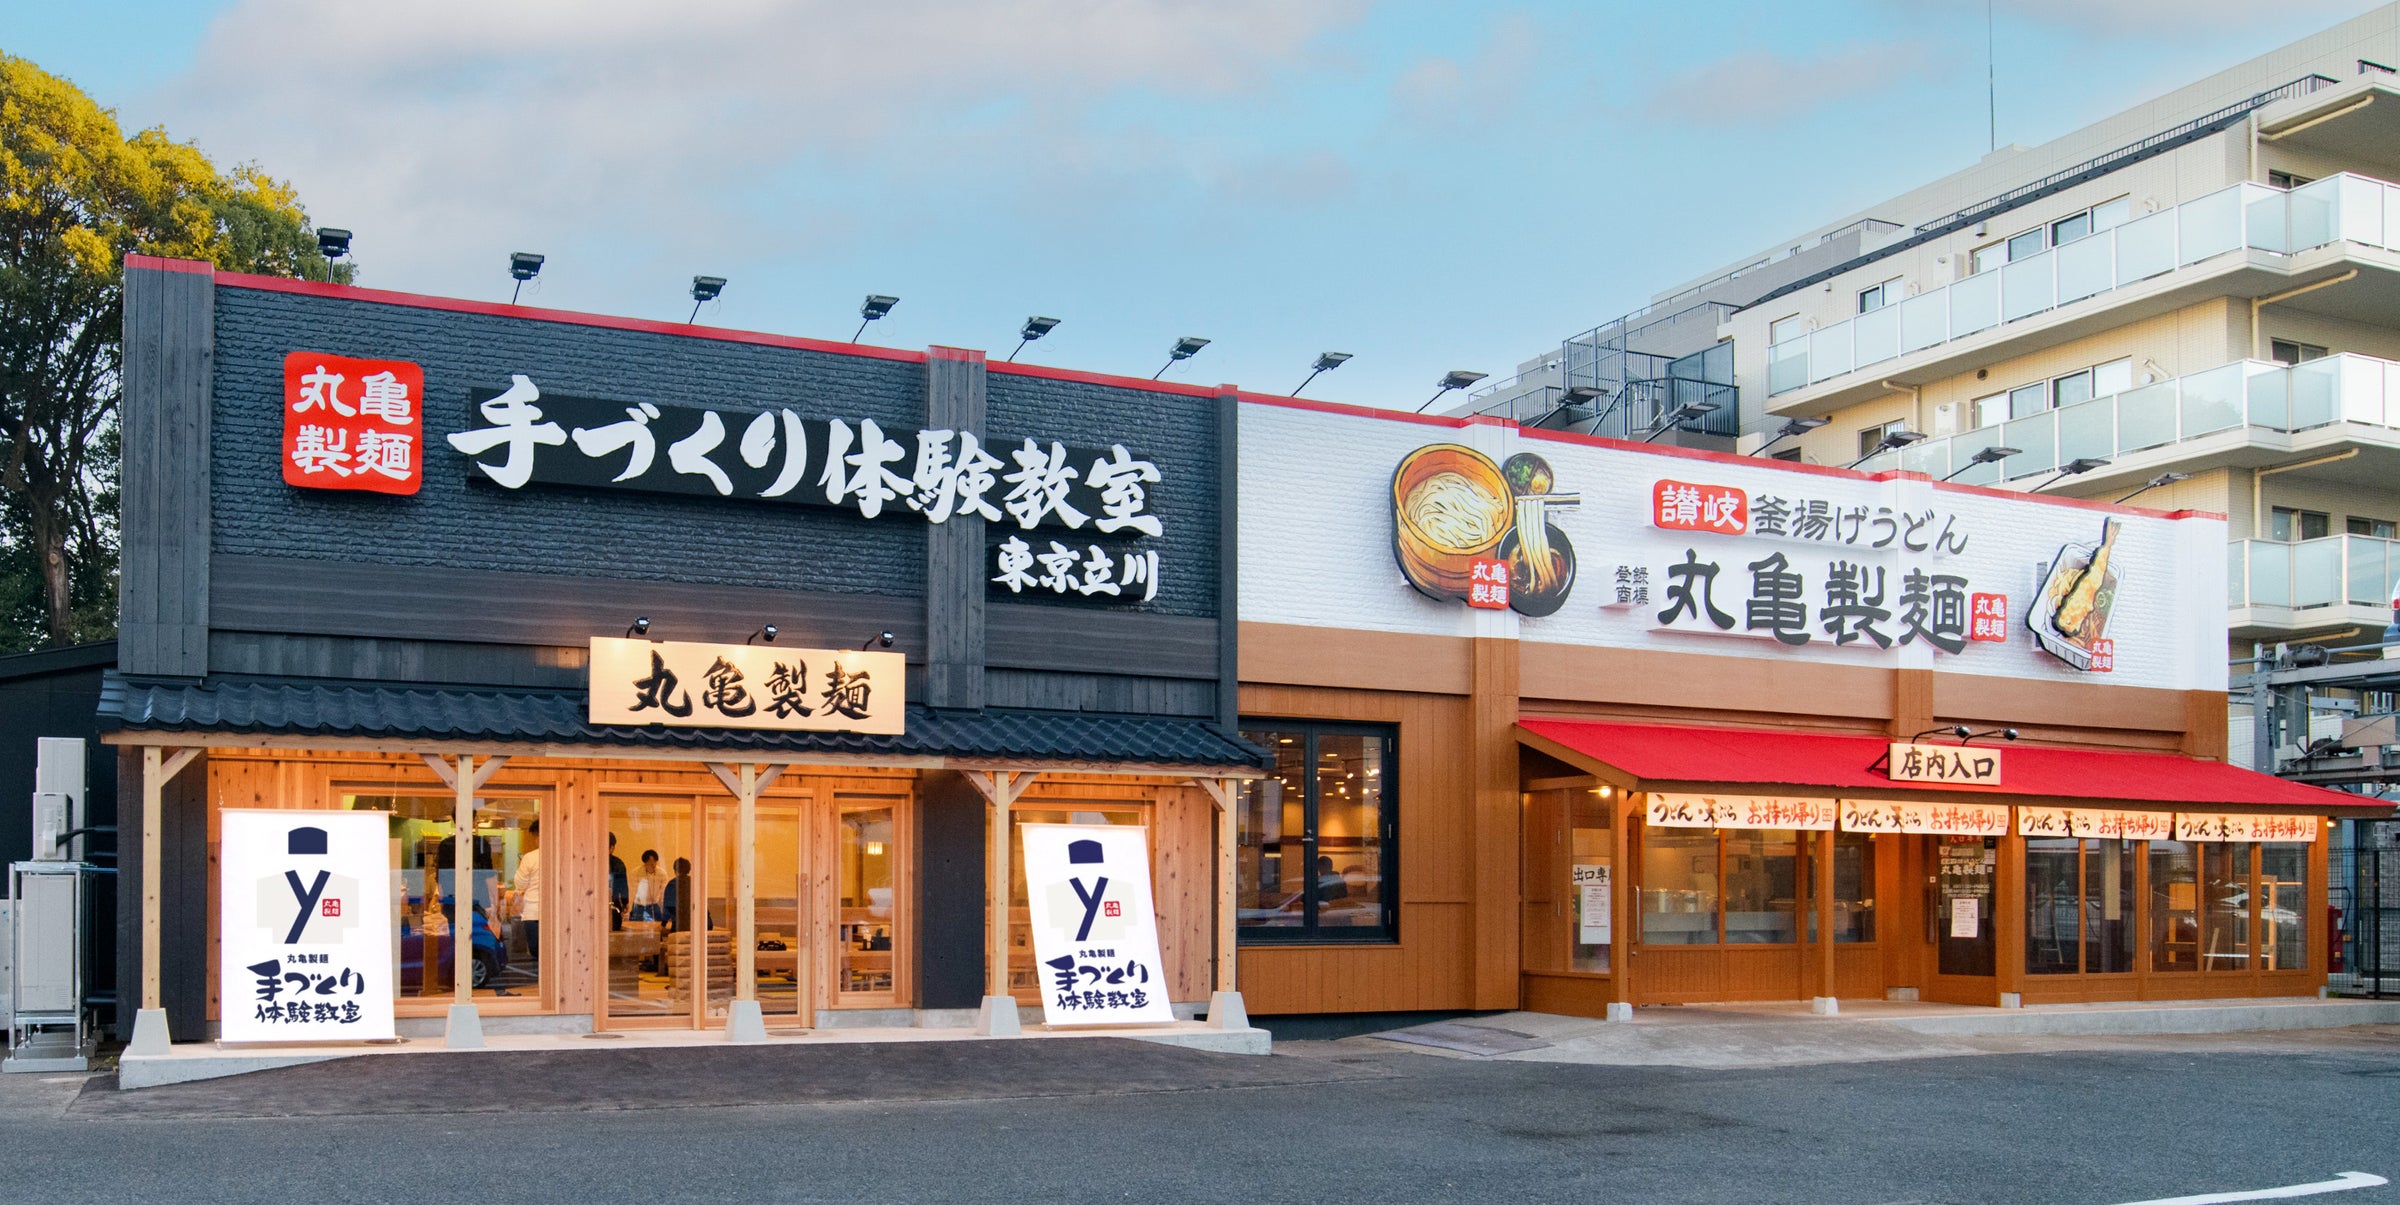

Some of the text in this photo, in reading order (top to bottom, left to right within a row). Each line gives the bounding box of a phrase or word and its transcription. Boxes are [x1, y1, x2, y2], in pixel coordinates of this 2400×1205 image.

[447, 375, 1163, 538] 手づくり体験教室
[991, 535, 1159, 602] 東京立川
[1658, 548, 1969, 656] 丸亀製麺
[629, 650, 873, 719] 丸亀製麺
[1900, 746, 1994, 779] 店内入口
[1573, 866, 1611, 883] 出口専
[287, 954, 329, 963] 丸亀製麺
[1079, 949, 1115, 958] 丸亀製麺
[246, 959, 364, 1001] 手づくり
[1045, 955, 1149, 991] 手づくり
[255, 1000, 362, 1024] 体験教室
[1057, 988, 1149, 1010] 体験教室
